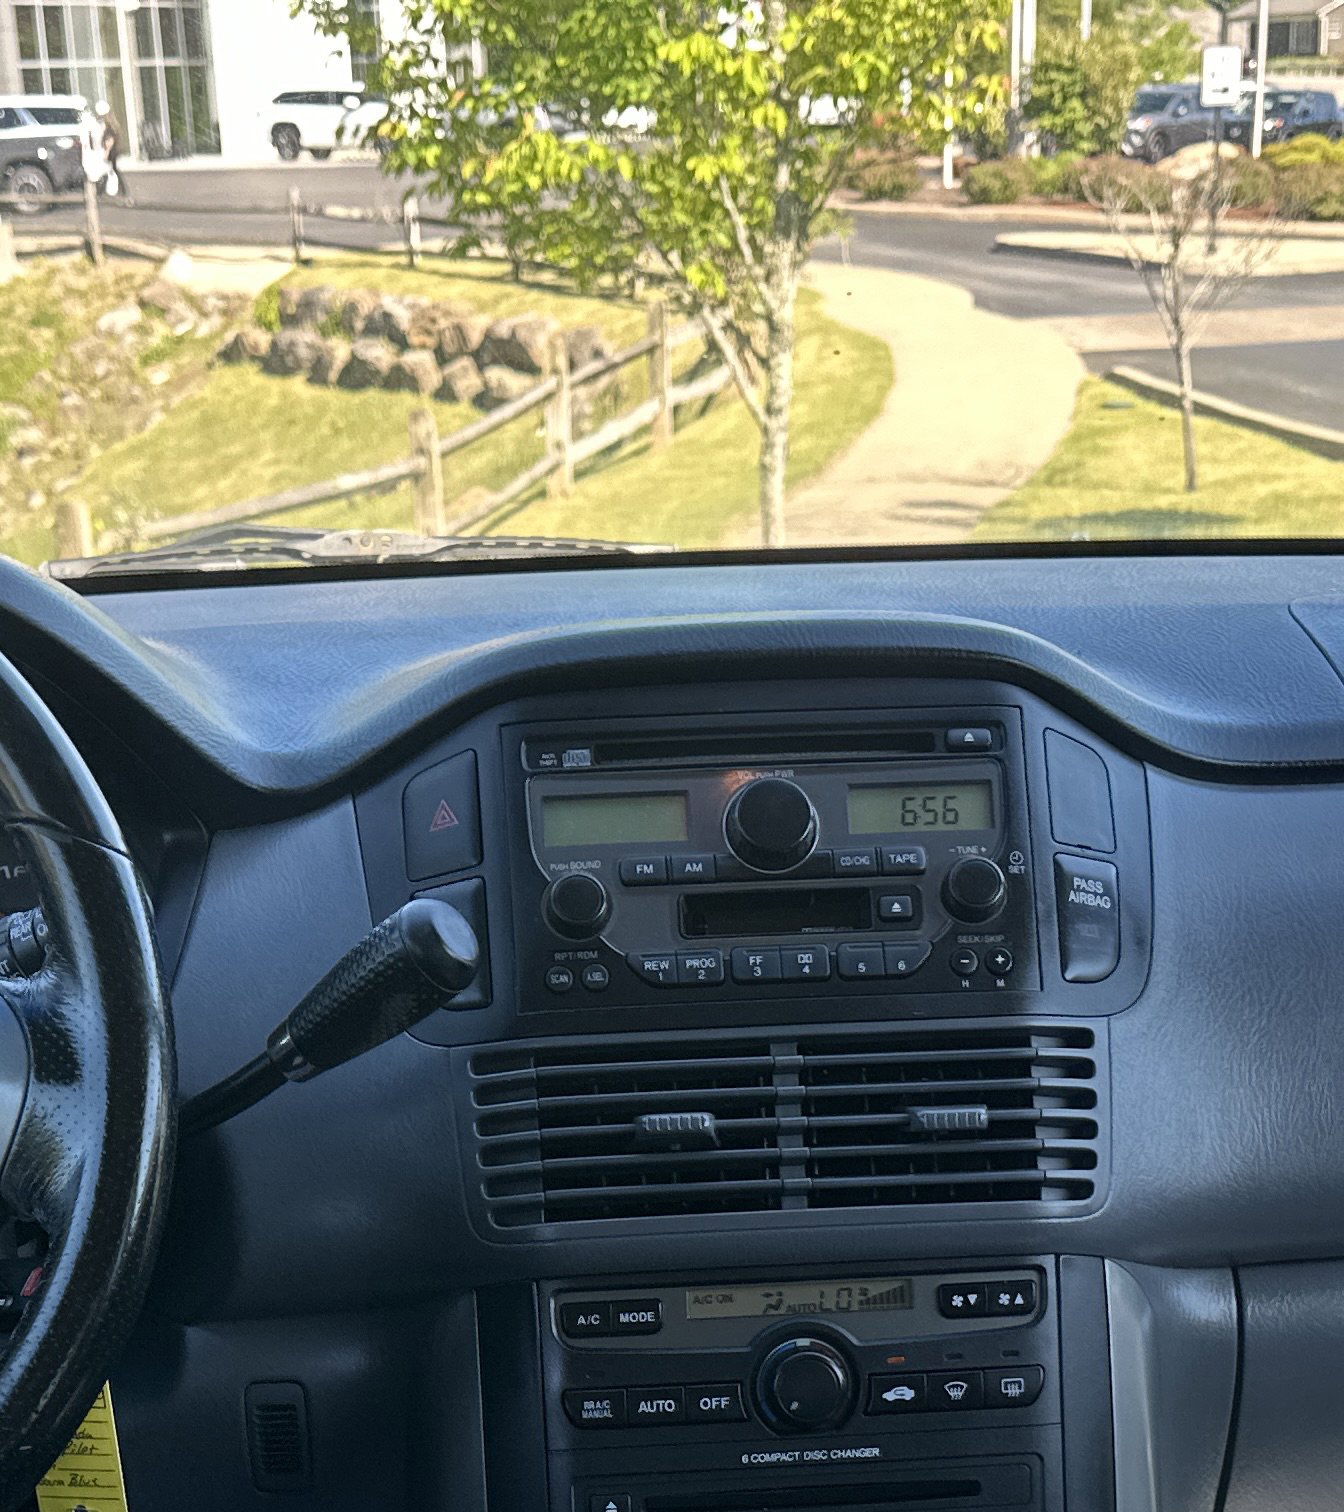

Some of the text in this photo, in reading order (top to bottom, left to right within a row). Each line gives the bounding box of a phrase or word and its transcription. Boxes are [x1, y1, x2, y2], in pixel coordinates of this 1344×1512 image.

[570, 860, 602, 870] SOUND
[888, 853, 918, 865] TAPE
[13, 865, 26, 878] F
[636, 863, 654, 875] FM
[684, 862, 703, 873] AM
[1008, 865, 1026, 875] SET
[1072, 876, 1104, 894] PASS
[1068, 889, 1111, 909] AIRBAG
[644, 960, 670, 971] REW
[685, 957, 716, 969] PROG
[749, 955, 764, 966] FF
[753, 966, 762, 977] 3
[802, 964, 810, 974] 4
[858, 962, 866, 973] 5
[550, 973, 569, 985] SCAN
[658, 972, 664, 981] 1
[698, 970, 706, 980] 2
[576, 1313, 601, 1326] A/C
[619, 1311, 656, 1323] MODE
[637, 1399, 676, 1414] AUTO
[699, 1396, 730, 1411] OFF
[741, 1447, 880, 1464] 6 COMPACT DISC CHANGER
